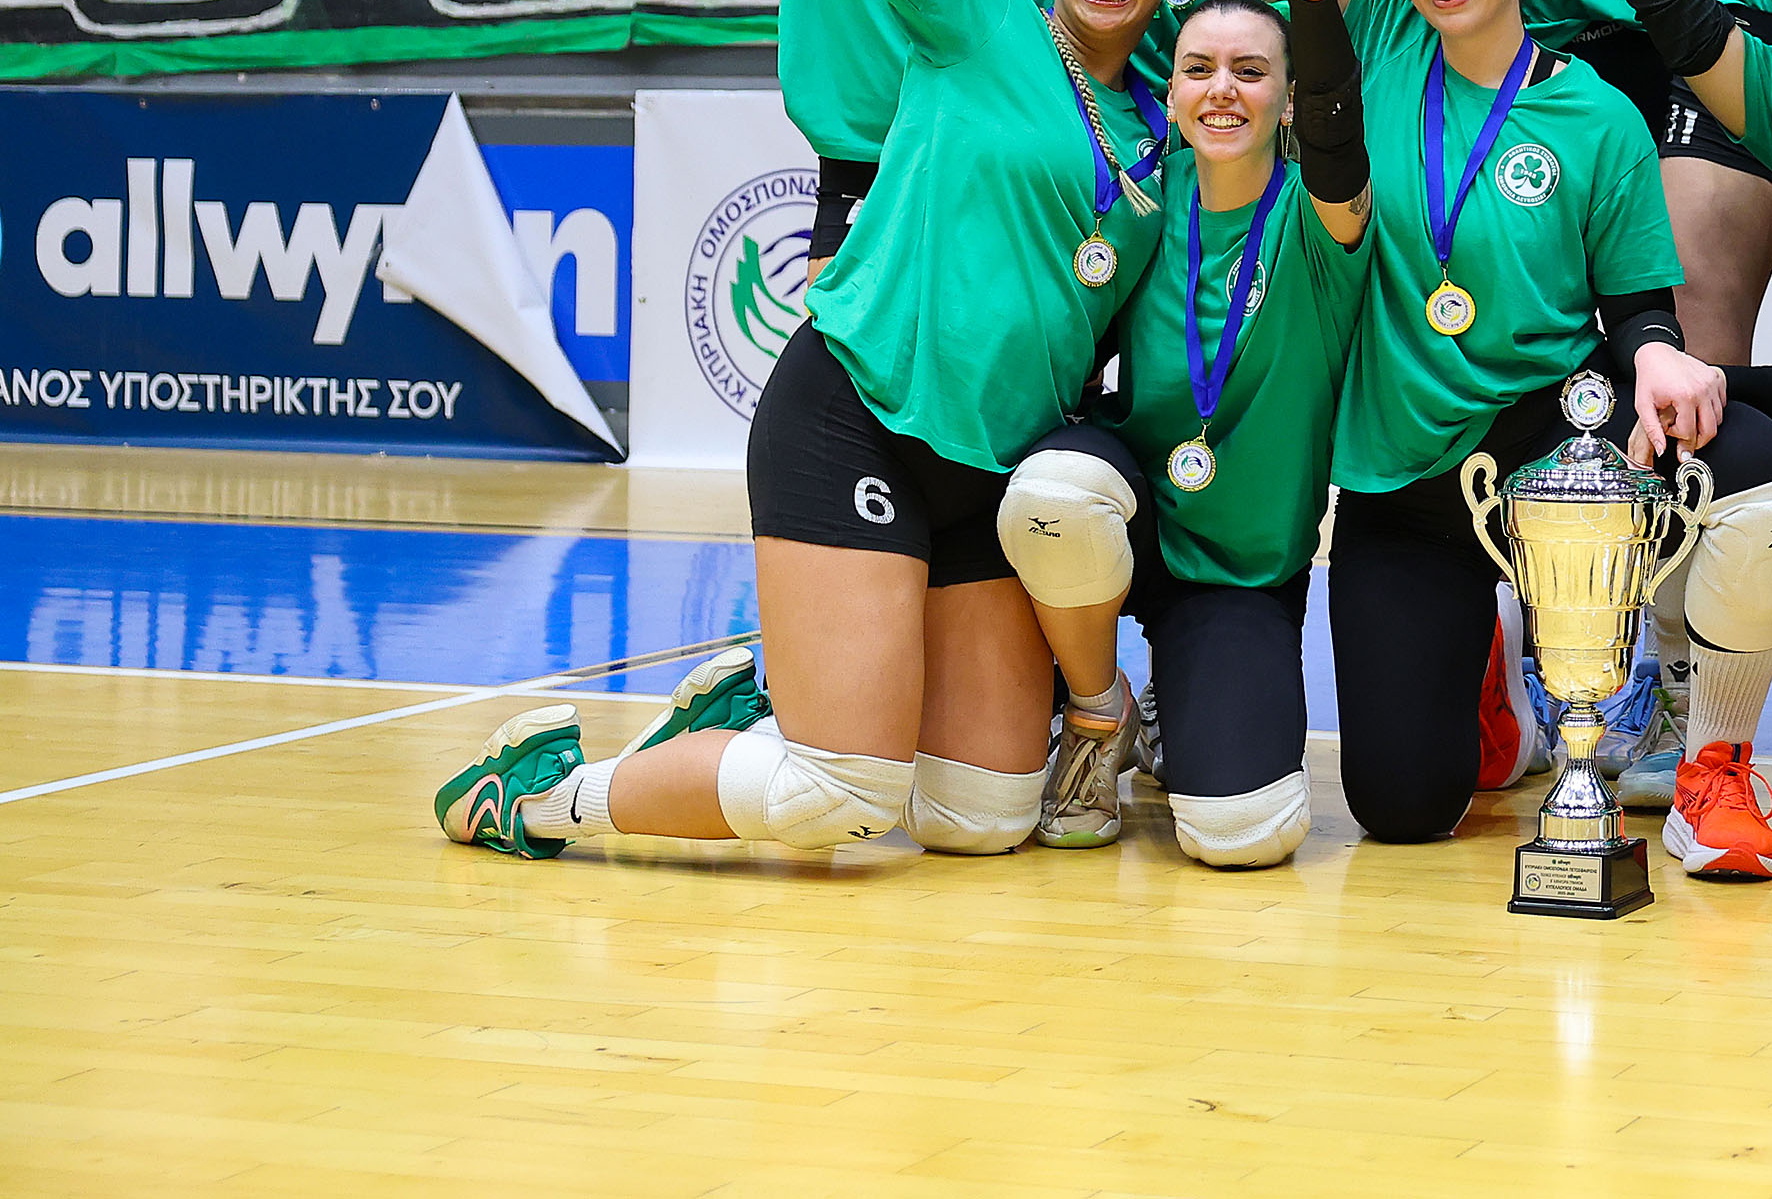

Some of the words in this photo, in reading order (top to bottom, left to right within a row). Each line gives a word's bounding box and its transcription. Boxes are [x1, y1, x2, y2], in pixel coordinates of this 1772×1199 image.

[700, 175, 820, 259] ΟΜΟΣΠΟΝΔ
[690, 275, 747, 403] ΚΥΠΡΙΑΚΗ
[100, 370, 379, 418] ΥΠΟΣΤΗΡΙΚΤΗΣ
[387, 379, 463, 420] ΣΟΥ
[854, 476, 895, 524] 6
